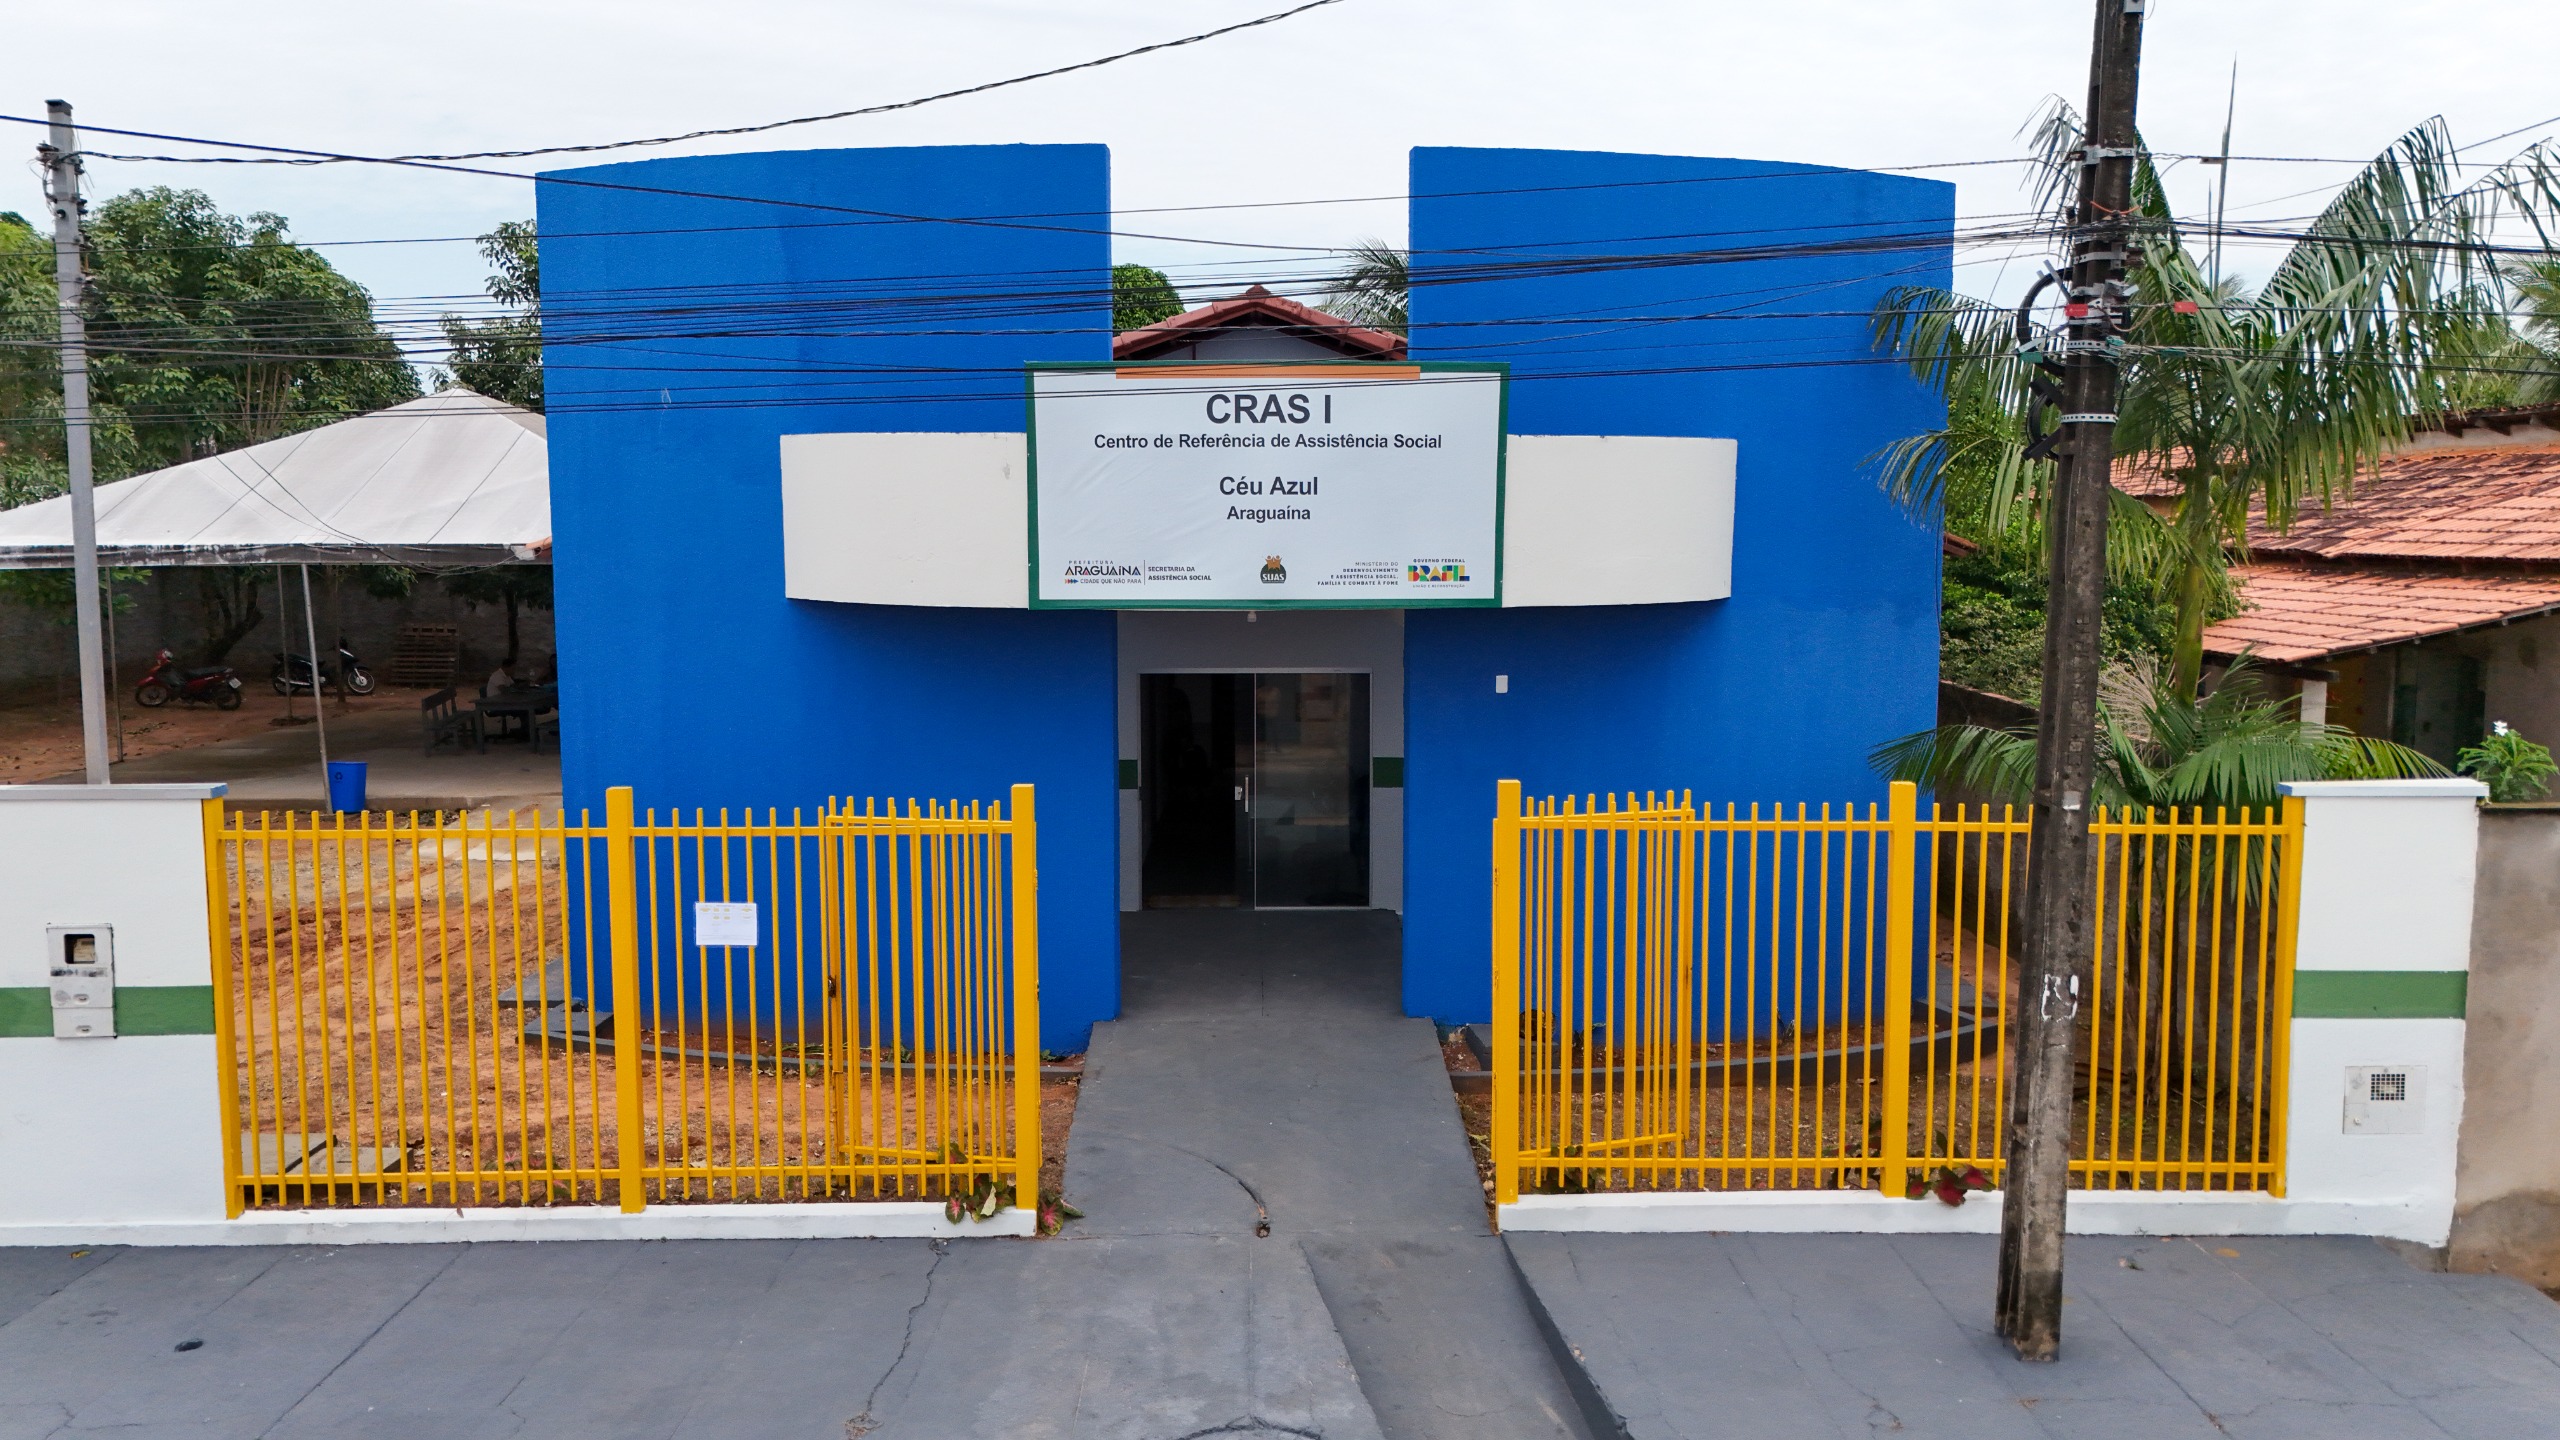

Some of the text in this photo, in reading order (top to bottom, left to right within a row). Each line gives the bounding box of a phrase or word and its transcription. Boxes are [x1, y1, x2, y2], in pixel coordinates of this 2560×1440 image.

[1205, 393, 1332, 425] CRAS I
[1094, 433, 1442, 449] Centro de Referência de Assistência Social
[1219, 475, 1318, 496] Céu Azul
[1226, 504, 1311, 524] Araguaína
[1262, 573, 1285, 581] SUAS
[1407, 565, 1471, 582] BRASIL
